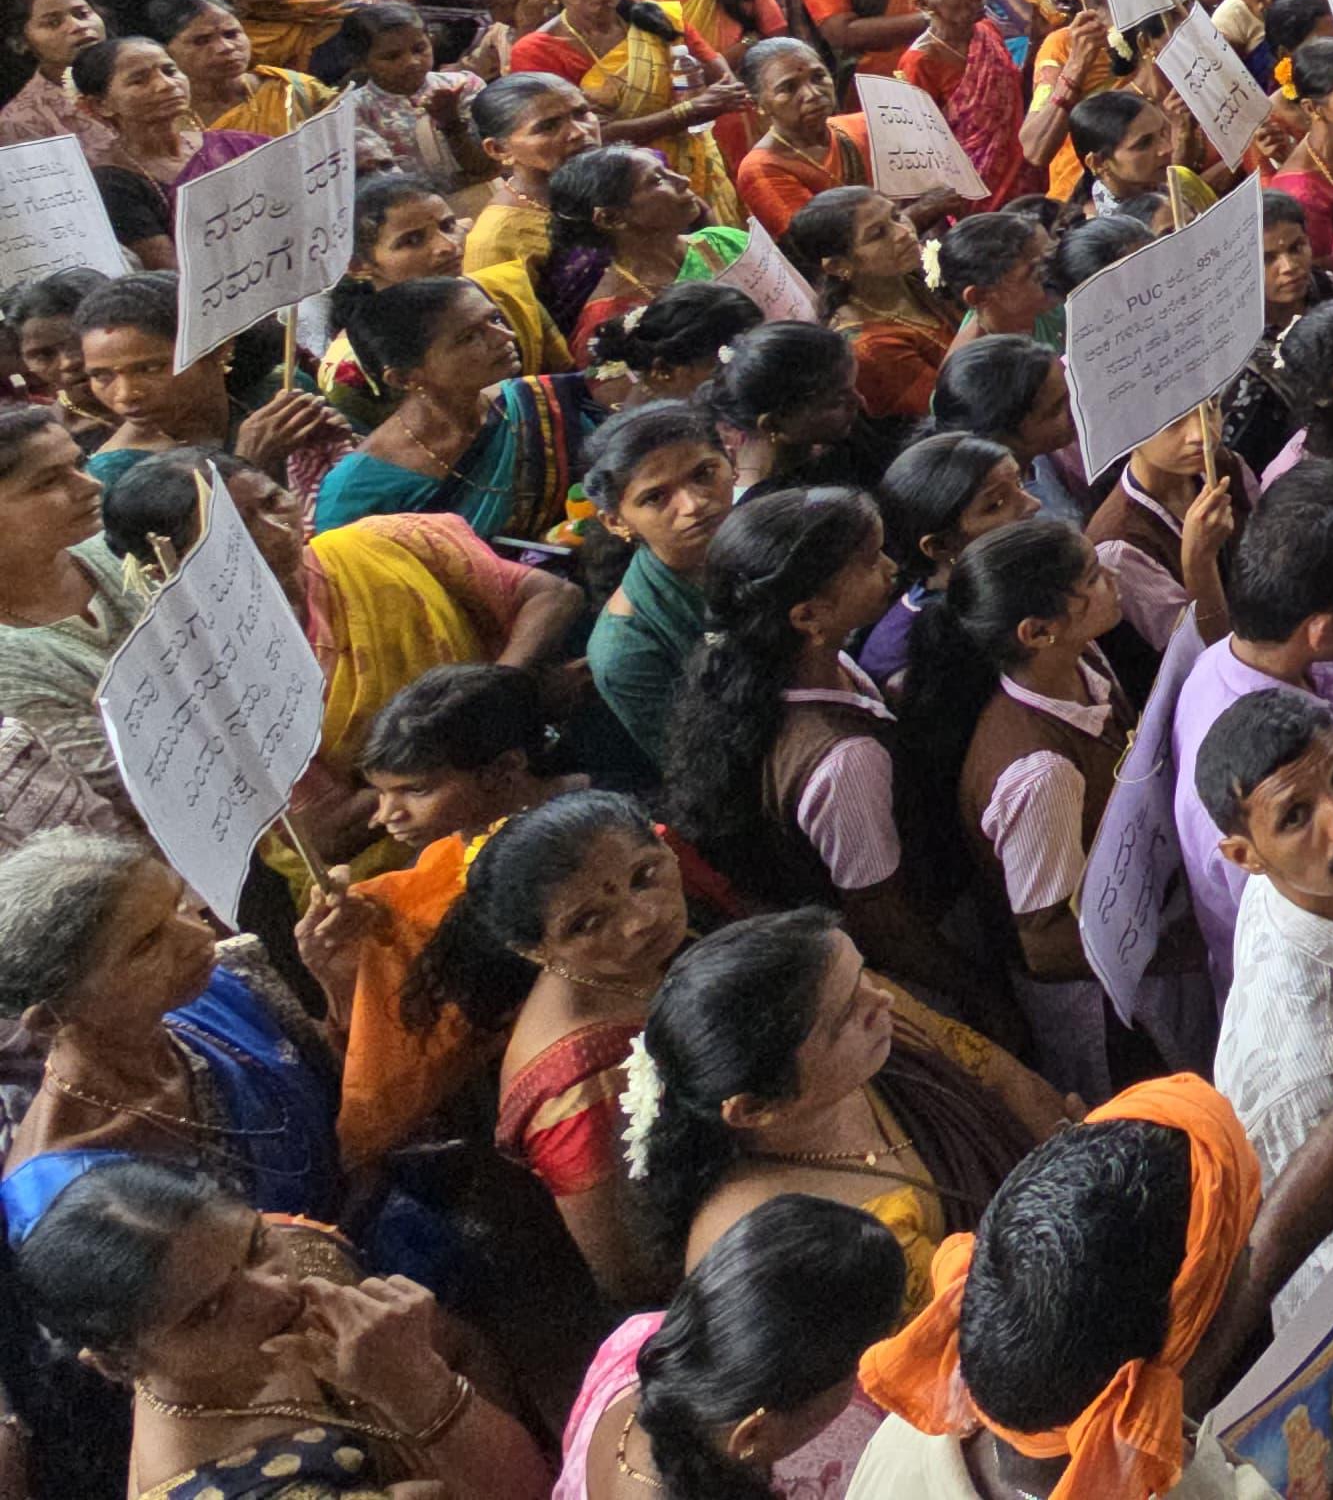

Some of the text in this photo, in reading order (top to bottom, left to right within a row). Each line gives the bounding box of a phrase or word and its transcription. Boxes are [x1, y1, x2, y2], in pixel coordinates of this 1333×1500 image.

[204, 193, 293, 248] ನಮ್ಮ
[200, 242, 294, 318] ನಮಗೆ
[1126, 283, 1164, 313] PUC
[1196, 247, 1222, 273] 95%
[123, 674, 159, 738] ನಾವು
[145, 633, 238, 789] ಸಮುದಾಯದ
[186, 733, 226, 810] ಎಂದು
[223, 682, 272, 738] ನಮ್ಮ
[211, 768, 258, 844] ಪರೀಕ್ಷೆ
